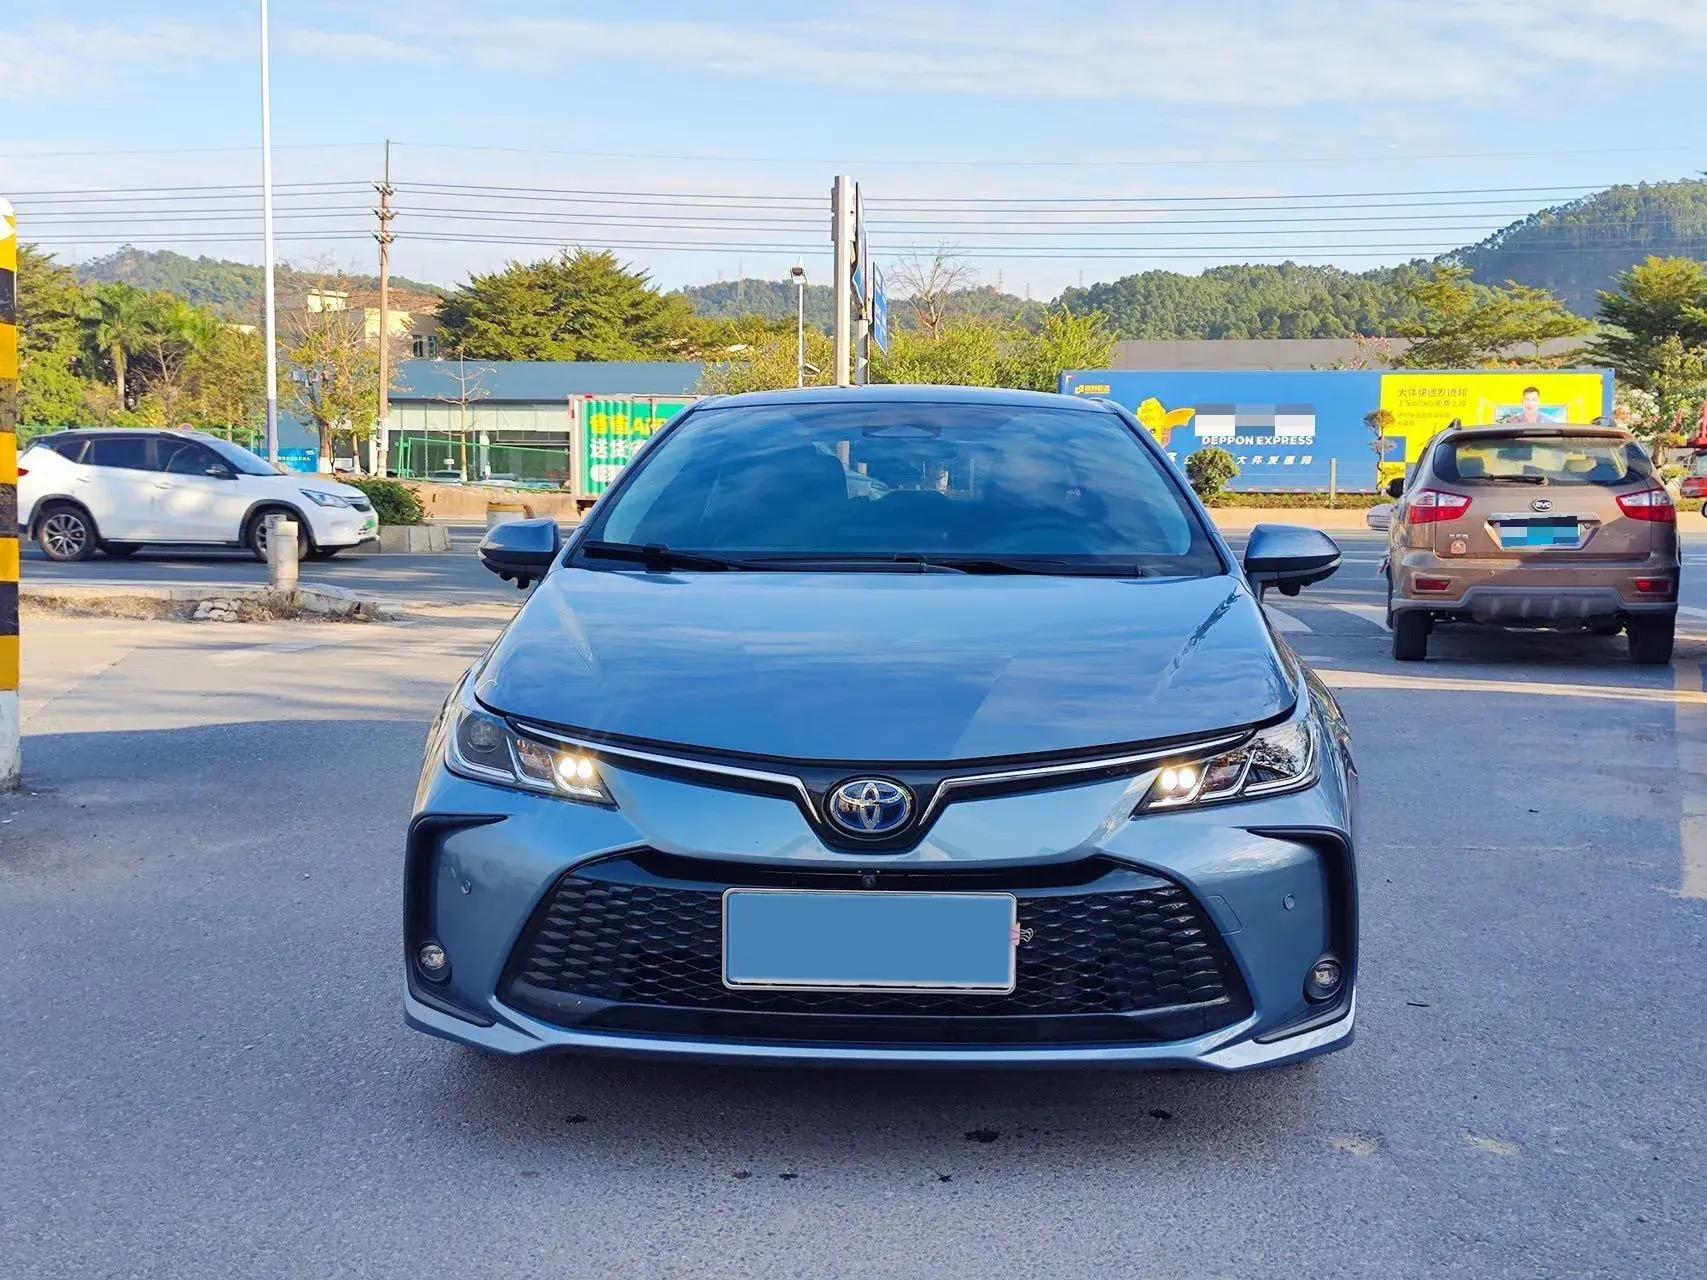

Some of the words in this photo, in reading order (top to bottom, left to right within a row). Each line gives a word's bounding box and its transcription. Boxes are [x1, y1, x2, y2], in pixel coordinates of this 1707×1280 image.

[1202, 436, 1254, 445] DEPPON
[1256, 436, 1314, 445] EXPRESS
[1534, 501, 1552, 509] BYD
